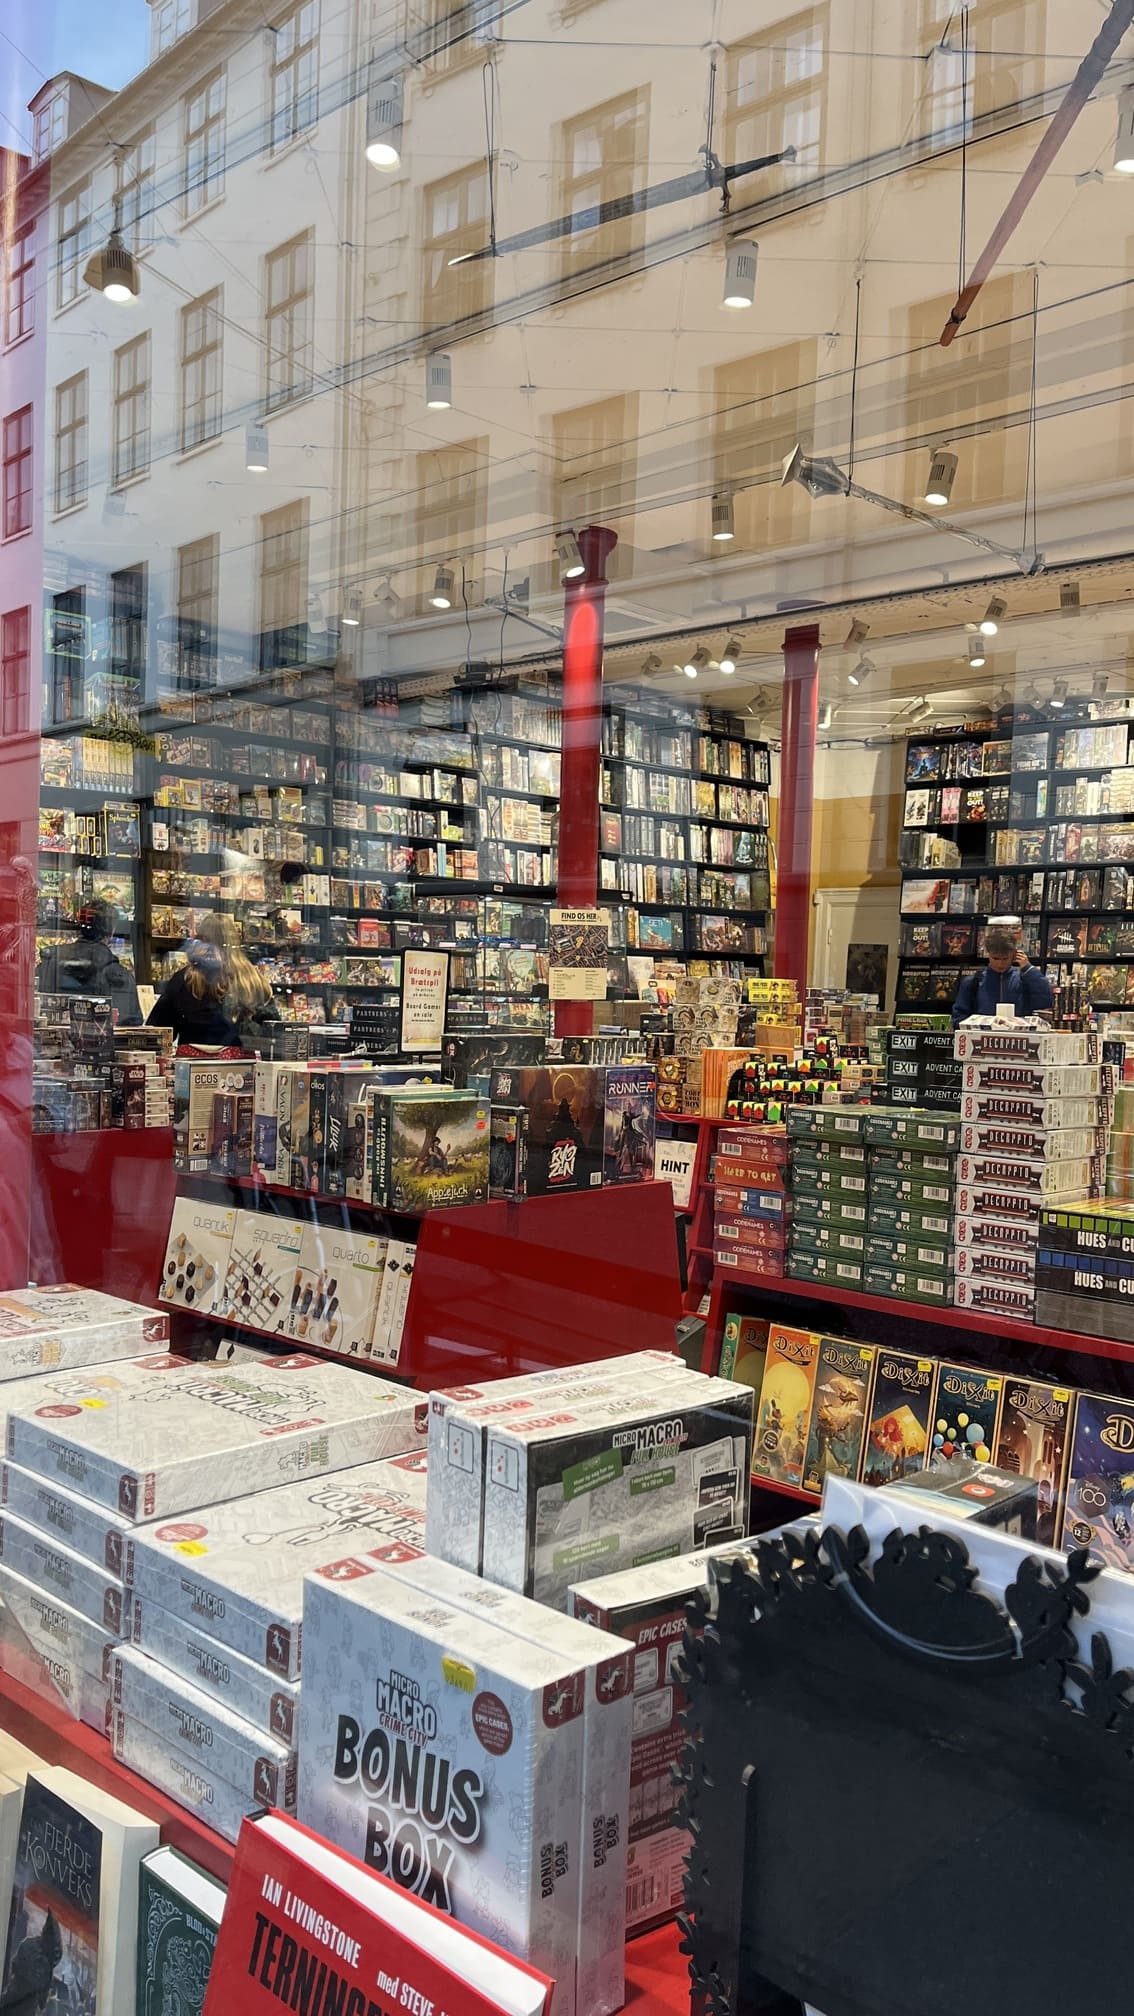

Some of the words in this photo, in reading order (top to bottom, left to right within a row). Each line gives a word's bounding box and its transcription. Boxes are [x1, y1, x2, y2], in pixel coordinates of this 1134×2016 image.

[561, 912, 576, 920] FIND
[577, 912, 586, 920] OS
[893, 1036, 916, 1048] EXIT
[924, 1036, 950, 1045] ADVENT
[194, 1073, 218, 1084] ecos
[894, 1062, 917, 1074] EXIT
[925, 1064, 952, 1072] ADVENT
[893, 1087, 916, 1100] EXIT
[924, 1090, 951, 1099] ADVENT
[736, 1136, 767, 1146] CODENAMES
[660, 1159, 690, 1174] HINT
[748, 1170, 758, 1180] TO
[760, 1172, 777, 1183] GET
[734, 1219, 764, 1230] CODENAMES
[732, 1246, 762, 1257] CODENAMES
[1077, 1231, 1106, 1249] HUES
[1074, 1272, 1104, 1290] HUES
[773, 1335, 815, 1358] Dixit
[822, 1347, 868, 1372] Dixit
[882, 1361, 930, 1387] Dixit
[943, 1375, 995, 1402] Dixit
[1008, 1389, 1065, 1418] Dixit
[614, 1432, 637, 1448] MICRO
[636, 1419, 683, 1451] MACRO
[1079, 1487, 1106, 1507] 100
[194, 1587, 225, 1618] MACRO
[638, 1626, 658, 1646] EPIC
[200, 1651, 230, 1684] MACRO
[390, 1668, 420, 1702] MICRO
[376, 1678, 437, 1740] MACRO
[182, 1712, 214, 1747] MACRO
[379, 1711, 407, 1738] CRIME
[406, 1726, 430, 1748] CITY
[184, 1766, 214, 1804] MACRO
[334, 1714, 485, 1844] BONUS
[593, 1814, 606, 1869] BONUS
[606, 1812, 619, 1850] BOX
[44, 1821, 92, 1878] FJERDE
[364, 1804, 455, 1915] BOX
[555, 1840, 568, 1878] BOX
[22, 1831, 92, 1909] KONVEKS
[541, 1842, 554, 1898] BONUS
[261, 1875, 283, 1908] IAN
[284, 1891, 362, 1969] LIVINGSTONE
[376, 1970, 400, 1998] med
[400, 1982, 435, 2016] STEVE
